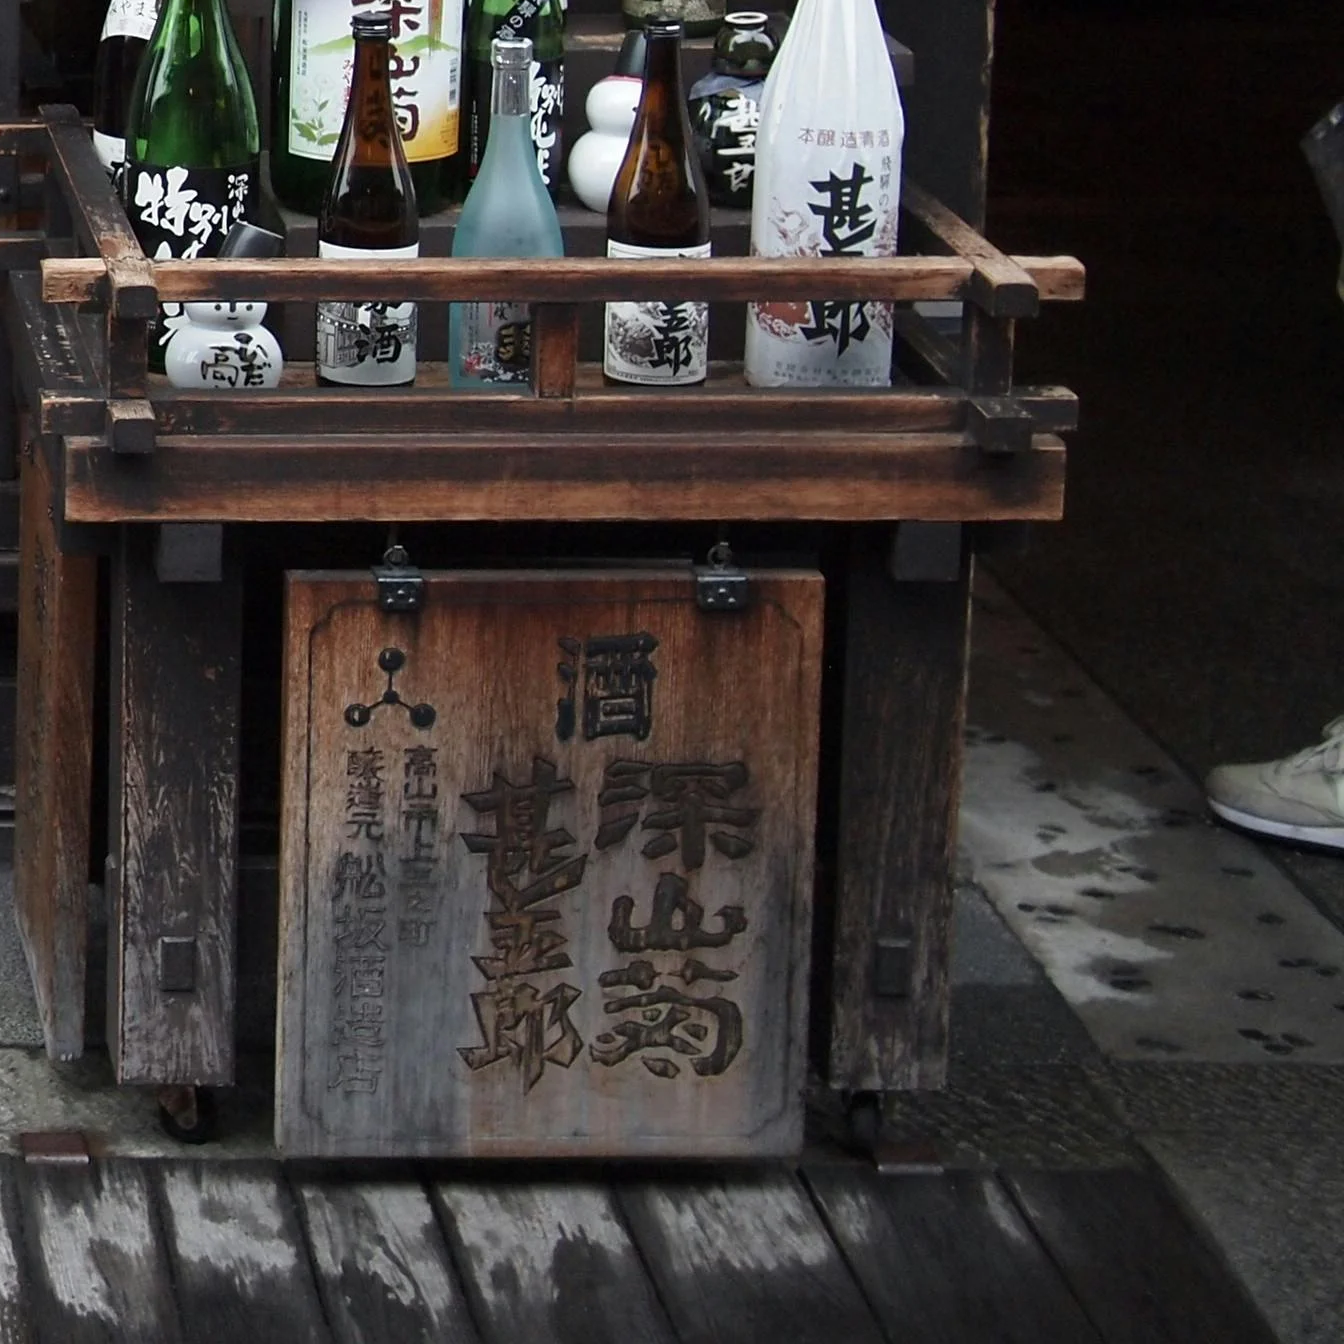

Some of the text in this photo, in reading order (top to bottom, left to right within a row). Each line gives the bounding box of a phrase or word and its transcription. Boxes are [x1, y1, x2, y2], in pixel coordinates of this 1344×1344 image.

[228, 173, 249, 222] 深山
[799, 161, 878, 359] 甚郎
[555, 631, 659, 742] 酒
[456, 757, 588, 1096] 甚五郎
[589, 759, 763, 1079] 深山菊
